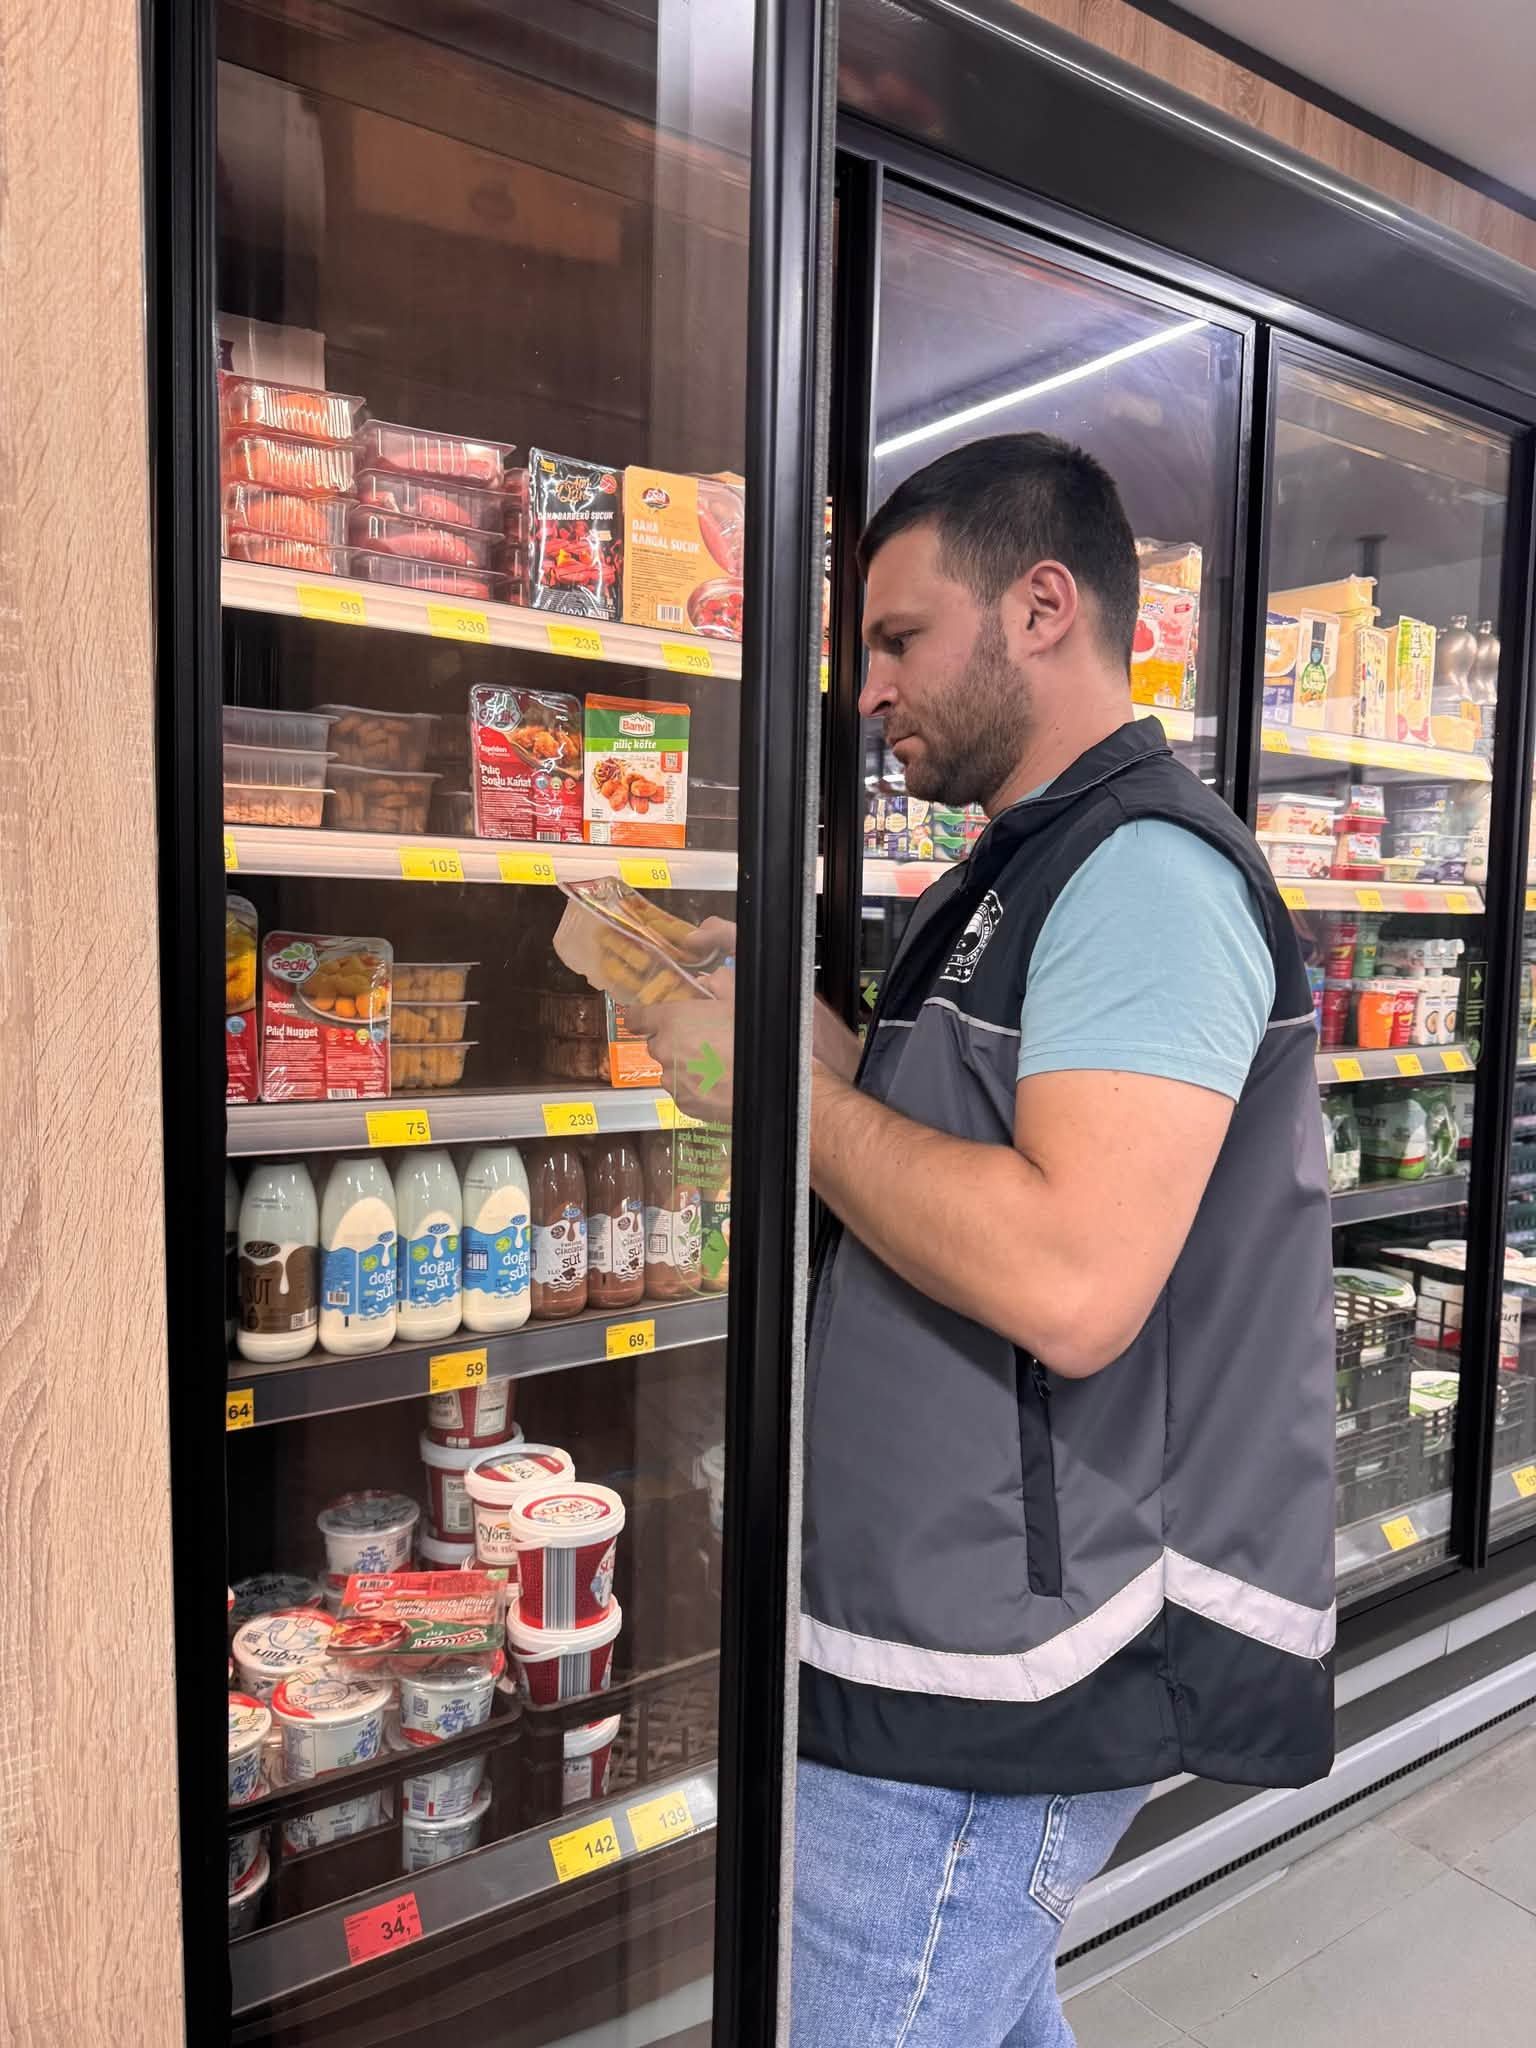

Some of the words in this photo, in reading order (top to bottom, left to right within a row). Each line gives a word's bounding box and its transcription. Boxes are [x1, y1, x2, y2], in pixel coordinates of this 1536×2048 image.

[591, 511, 614, 520] SUCUK
[339, 601, 361, 615] 99
[456, 619, 485, 634] 339
[573, 637, 600, 651] 235
[622, 720, 652, 732] Banvit
[612, 740, 633, 751] piliç
[634, 740, 657, 749] köfte
[481, 765, 501, 778] Piliç
[482, 776, 506, 787] Soslu
[429, 859, 458, 873] 105
[533, 864, 551, 877] 99
[651, 868, 667, 881] 89
[286, 1027, 319, 1038] Nugget
[569, 1113, 594, 1127] 239
[406, 1121, 426, 1136] 75
[419, 1259, 454, 1279] doğal
[427, 1274, 450, 1292] süt
[466, 1362, 484, 1377] 59
[228, 1403, 249, 1420] 64
[660, 1807, 688, 1829] 139
[584, 1835, 615, 1859] 142
